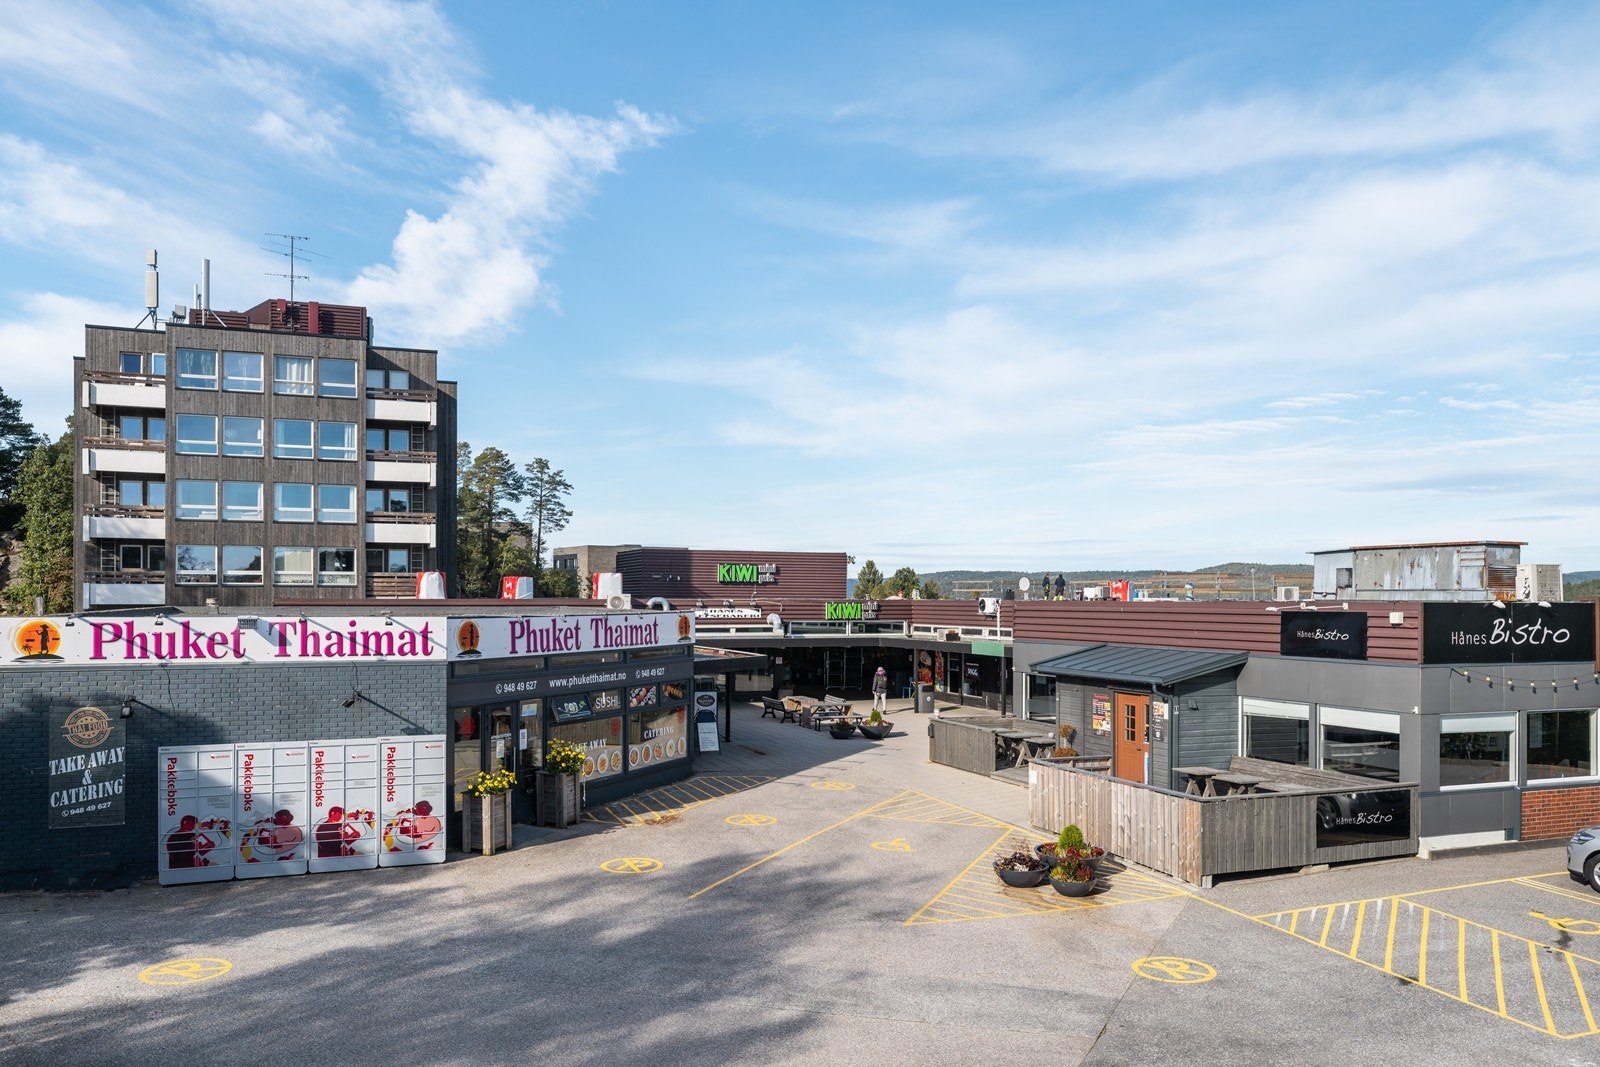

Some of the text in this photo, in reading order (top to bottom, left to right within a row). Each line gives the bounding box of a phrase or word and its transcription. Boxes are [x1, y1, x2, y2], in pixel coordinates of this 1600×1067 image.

[718, 564, 757, 582] KIWI
[826, 602, 861, 620] KIWI
[89, 619, 434, 660] Phuket Thaimat
[509, 616, 659, 654] Phuket Thaimat
[1296, 628, 1350, 640] Hånes Bistro
[1451, 618, 1570, 645] Hånes Bistro
[549, 672, 627, 688] www.phuketthaimat.no
[641, 667, 665, 678] 948 49 627
[503, 681, 537, 692] 948 49 627
[69, 721, 108, 735] THAI FOOD
[643, 725, 674, 740] CATERING
[49, 747, 125, 776] TAKE AWAY
[82, 769, 93, 785] &
[243, 754, 254, 812] Pakkeboks
[315, 751, 324, 807] Pakkeboks
[386, 747, 396, 802] Pakkeboks
[50, 778, 123, 808] CATERING
[167, 757, 177, 817] Pakkeboks
[70, 801, 112, 816] 948 49 627
[1356, 811, 1393, 825] Bistro
